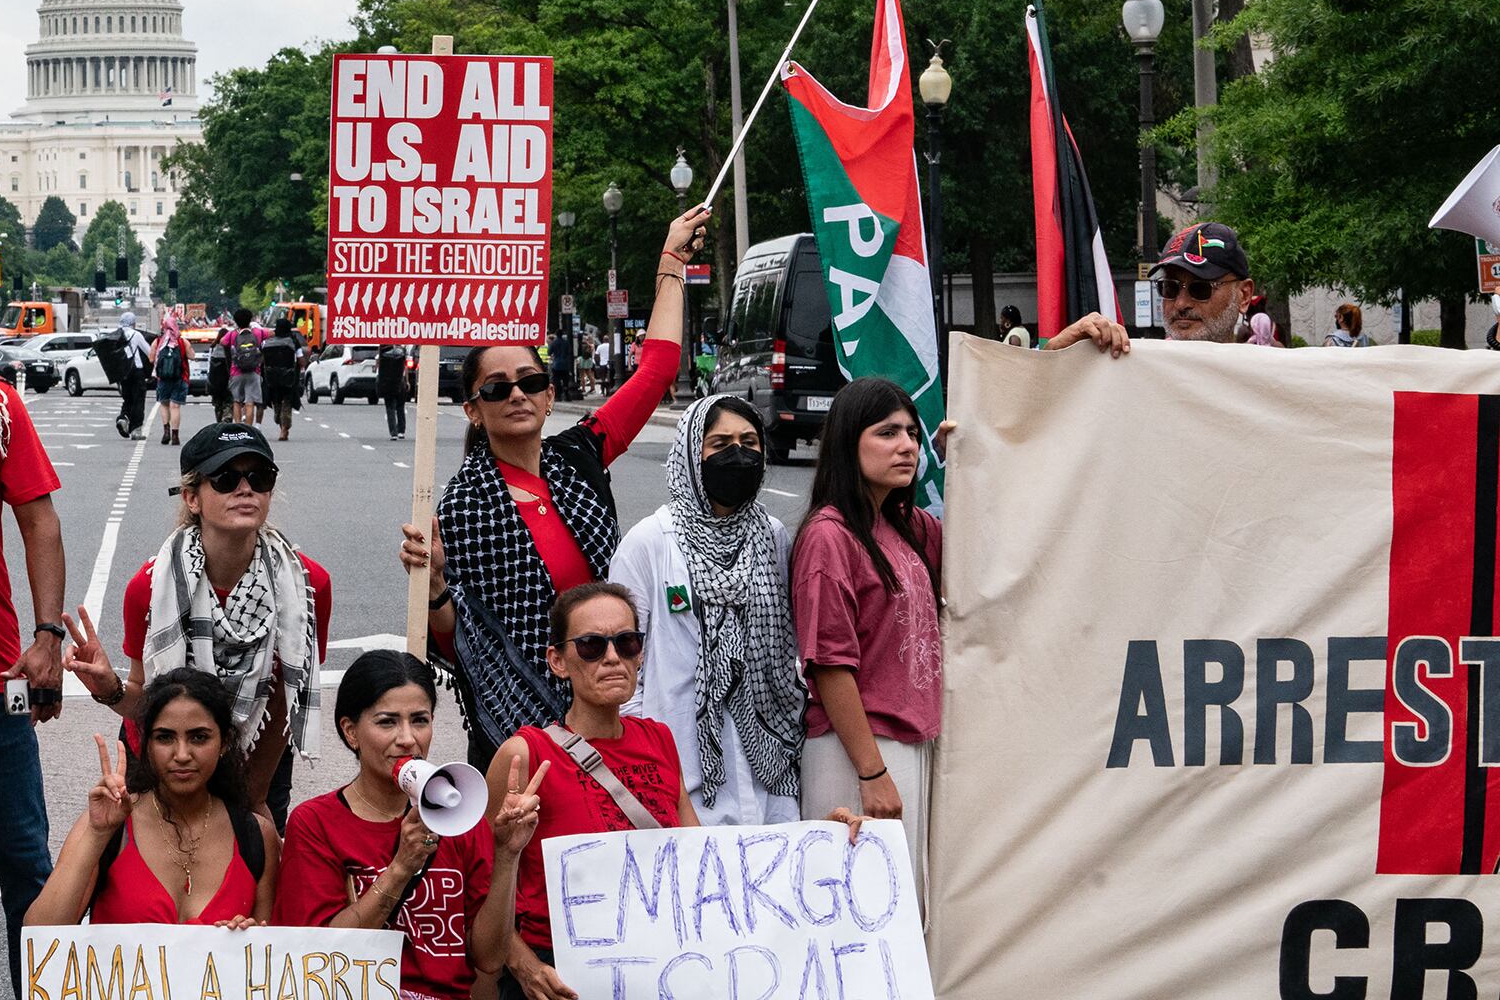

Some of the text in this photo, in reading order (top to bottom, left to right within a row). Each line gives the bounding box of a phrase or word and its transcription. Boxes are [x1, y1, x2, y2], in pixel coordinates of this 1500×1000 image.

[337, 60, 550, 121] END ALL
[336, 122, 547, 183] U.S. AID
[333, 186, 546, 235] TO ISRAEL
[334, 243, 544, 275] STOP THE GENOCIDE
[332, 316, 540, 341] #ShutItDown4Palestine
[1105, 635, 1500, 768] ARREST
[561, 830, 901, 950] EMARGO
